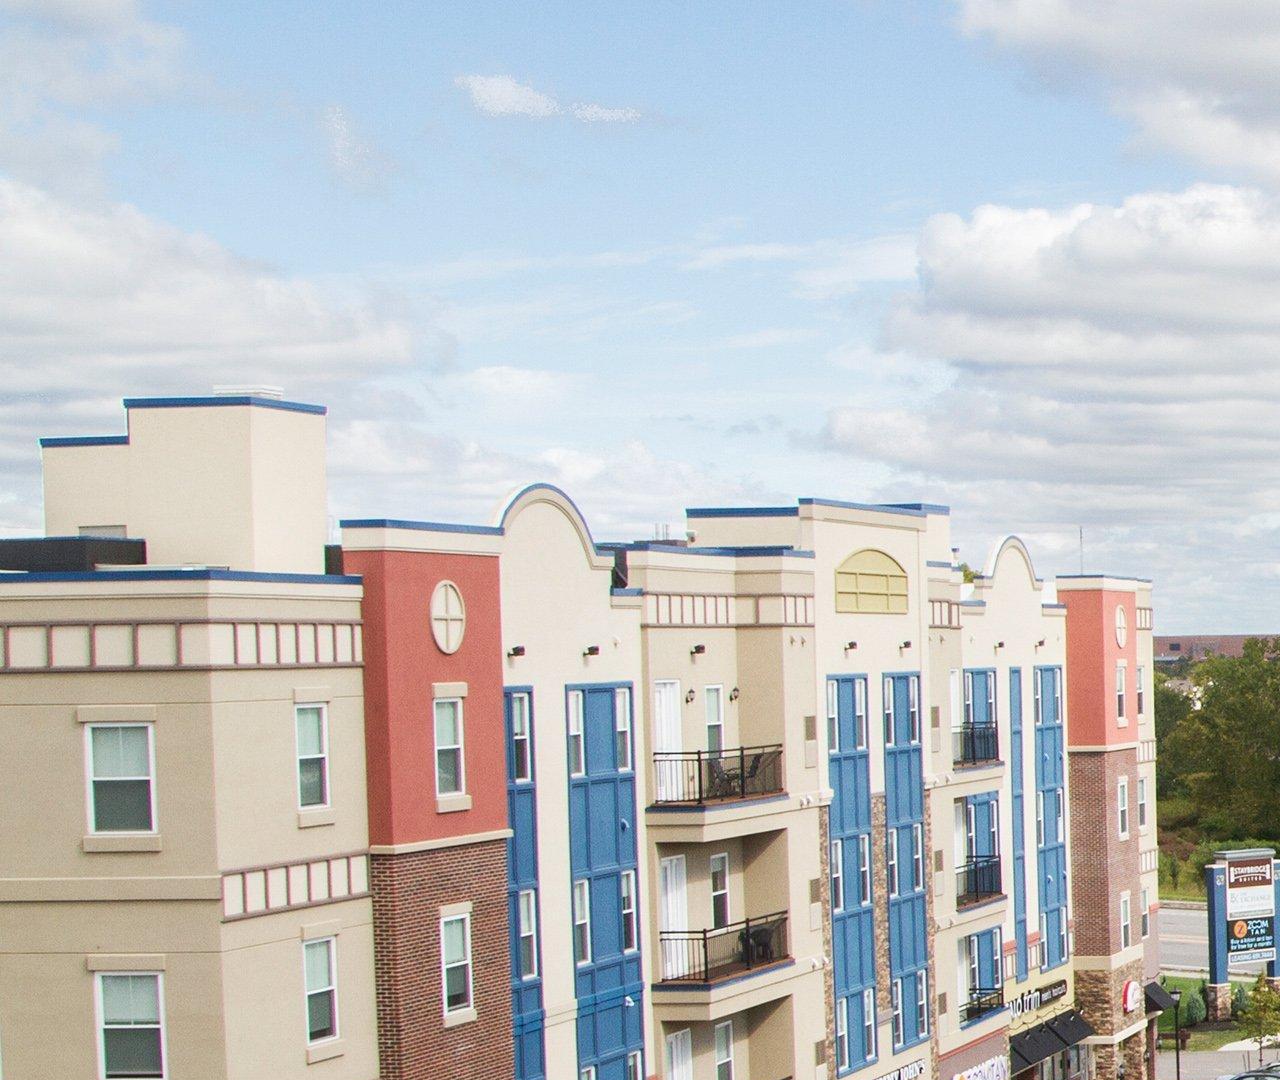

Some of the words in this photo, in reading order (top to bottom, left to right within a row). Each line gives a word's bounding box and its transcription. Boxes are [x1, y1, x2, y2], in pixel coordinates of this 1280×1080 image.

[1234, 866, 1266, 874] STAYBRIDGE
[1247, 920, 1269, 929] ZOOM
[1023, 990, 1040, 1012] trim
